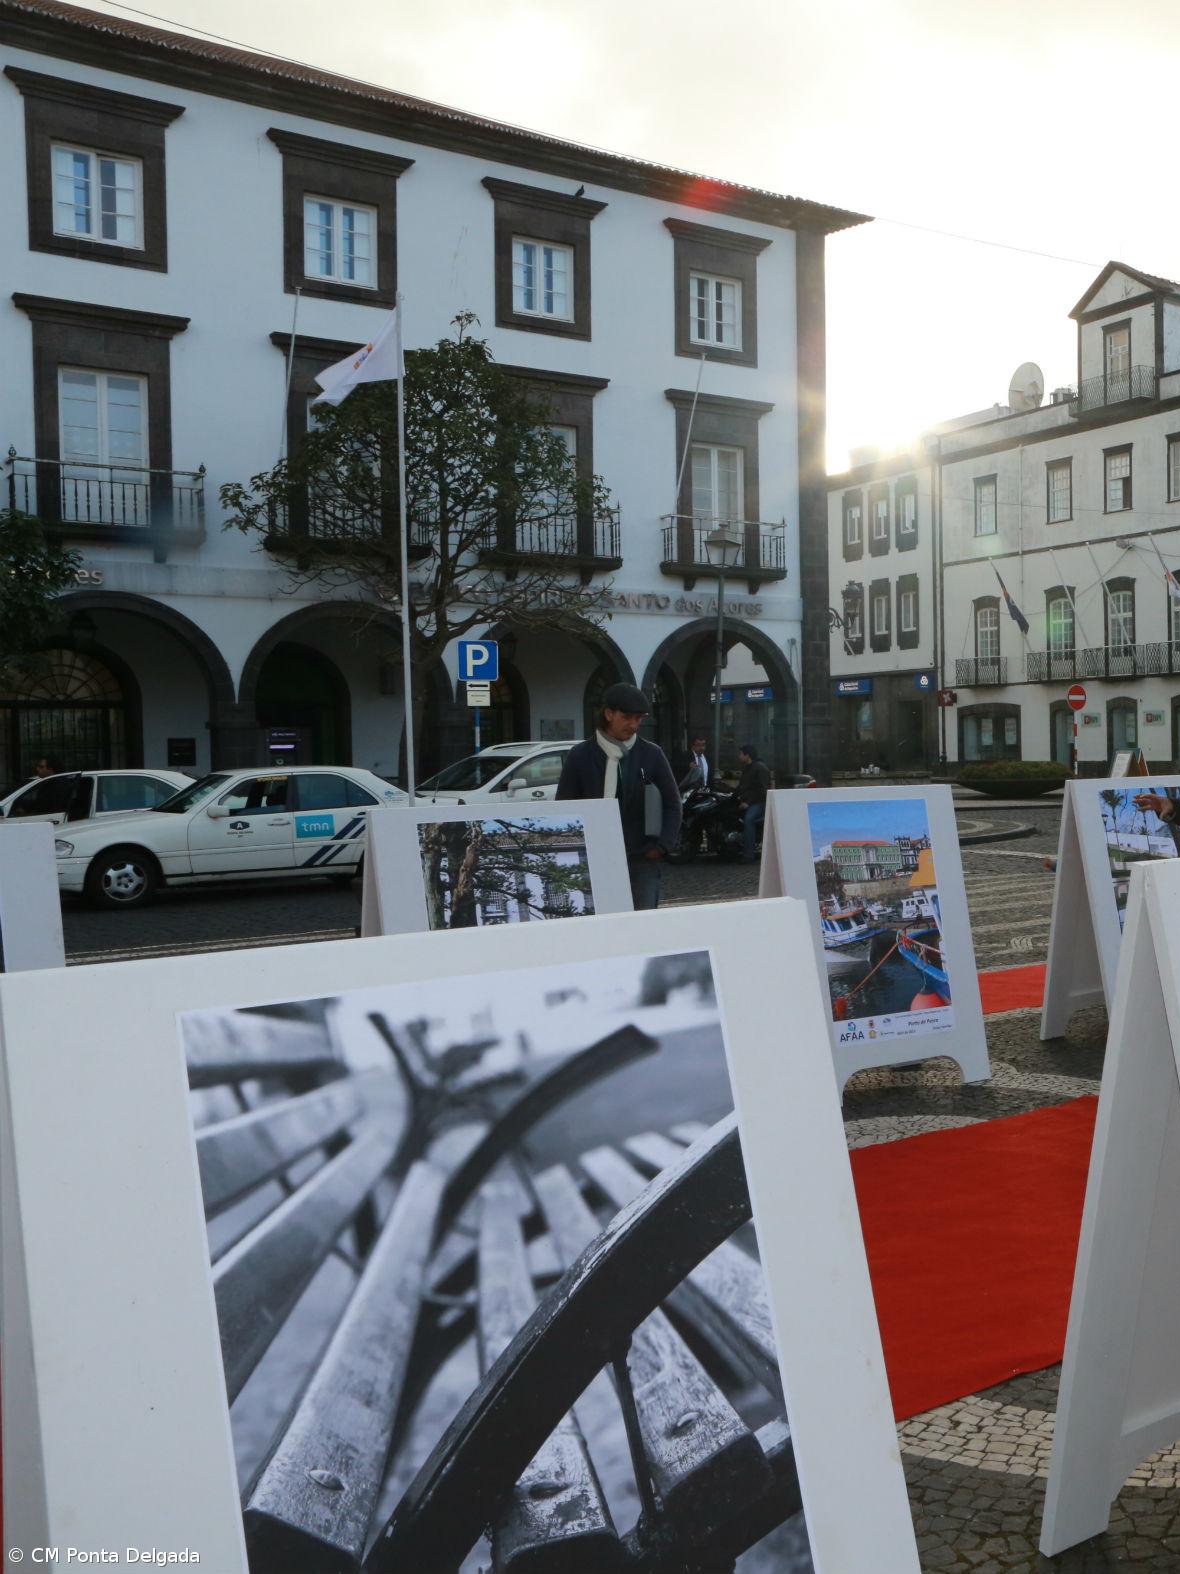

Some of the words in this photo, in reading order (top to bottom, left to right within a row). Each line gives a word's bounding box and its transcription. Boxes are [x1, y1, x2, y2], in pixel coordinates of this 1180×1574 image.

[466, 644, 489, 677] P
[302, 821, 330, 833] tmn
[840, 1030, 865, 1043] AFAA
